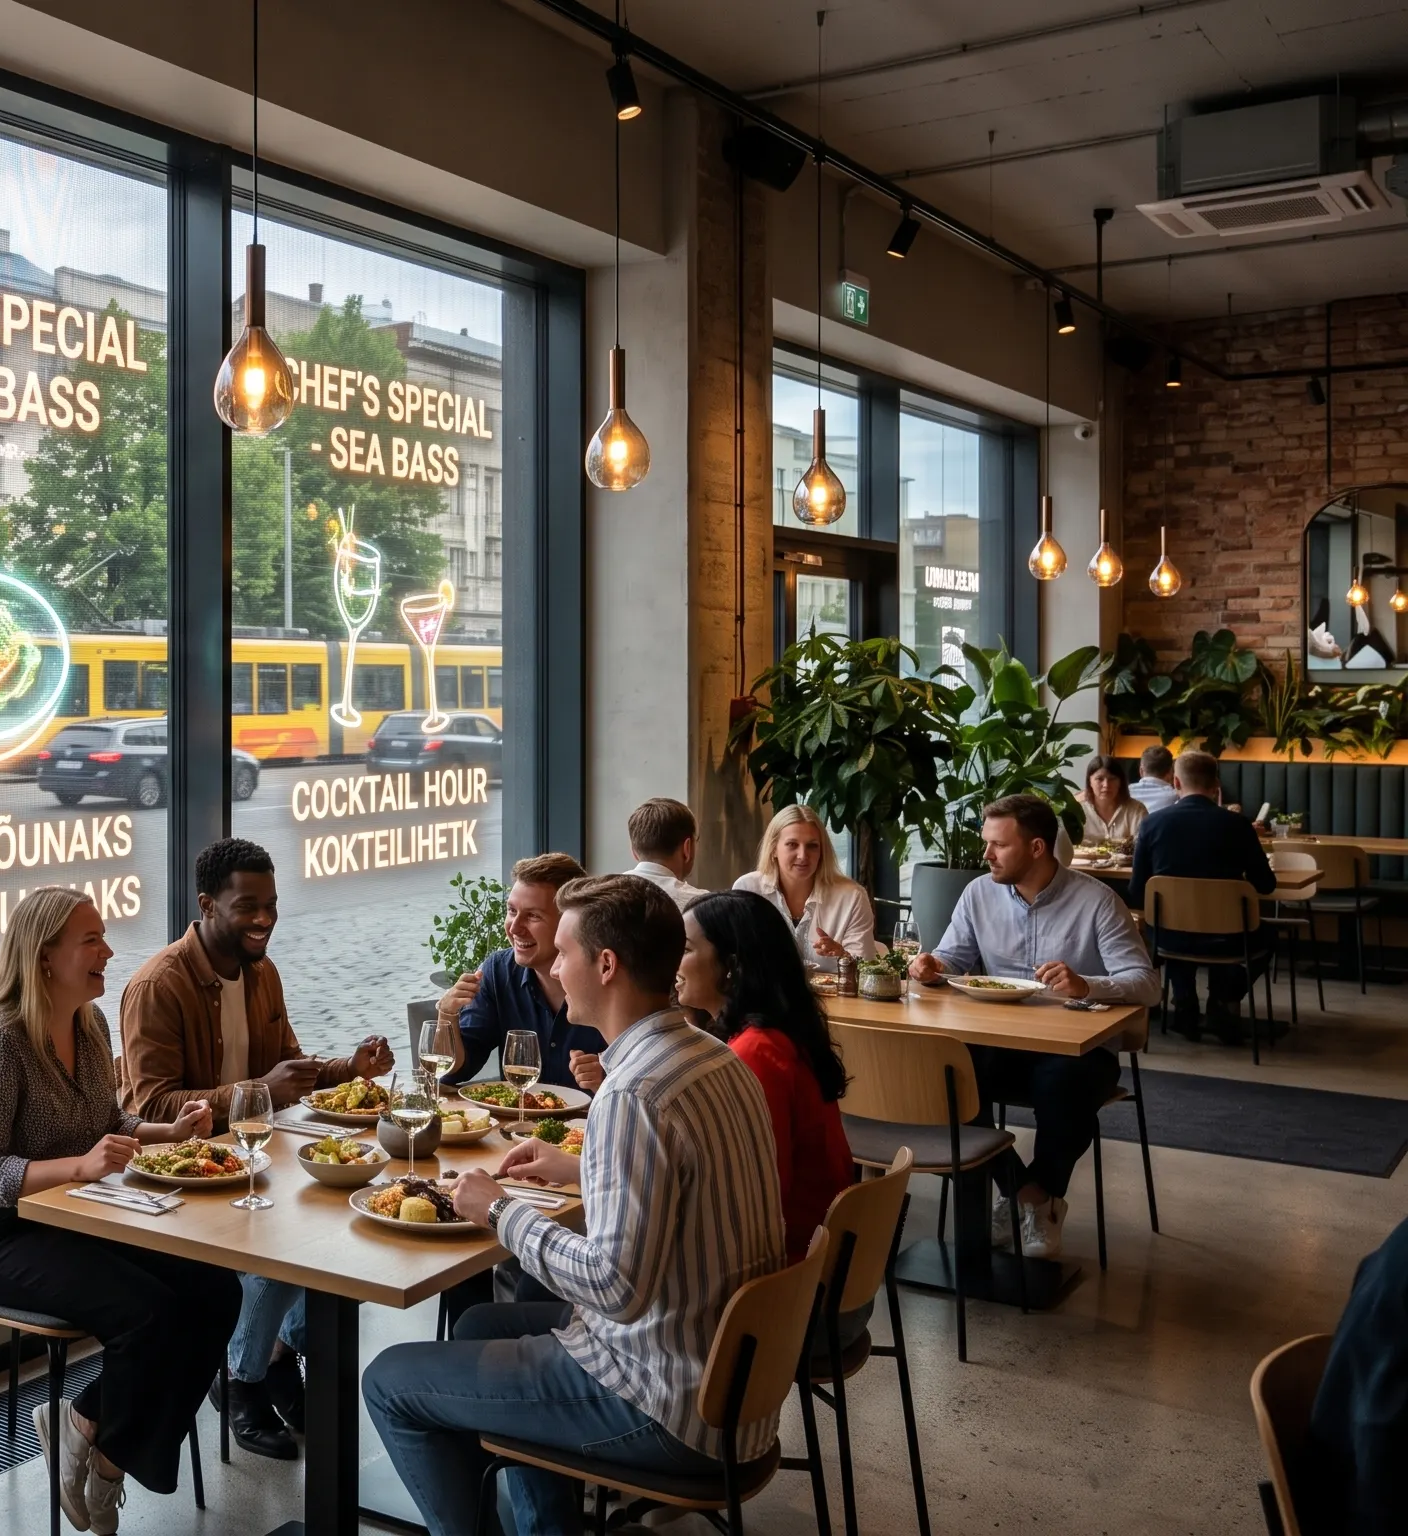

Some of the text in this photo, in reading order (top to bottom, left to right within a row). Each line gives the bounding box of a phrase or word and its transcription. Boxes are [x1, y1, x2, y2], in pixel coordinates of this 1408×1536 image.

[387, 380, 493, 439] SPECIAL
[330, 426, 385, 475] SEA
[392, 438, 459, 486] BASS
[291, 767, 488, 822] COCKTAIL HOUR
[304, 818, 478, 878] KOKTEILIHETK
[0, 875, 141, 934] LAKS
